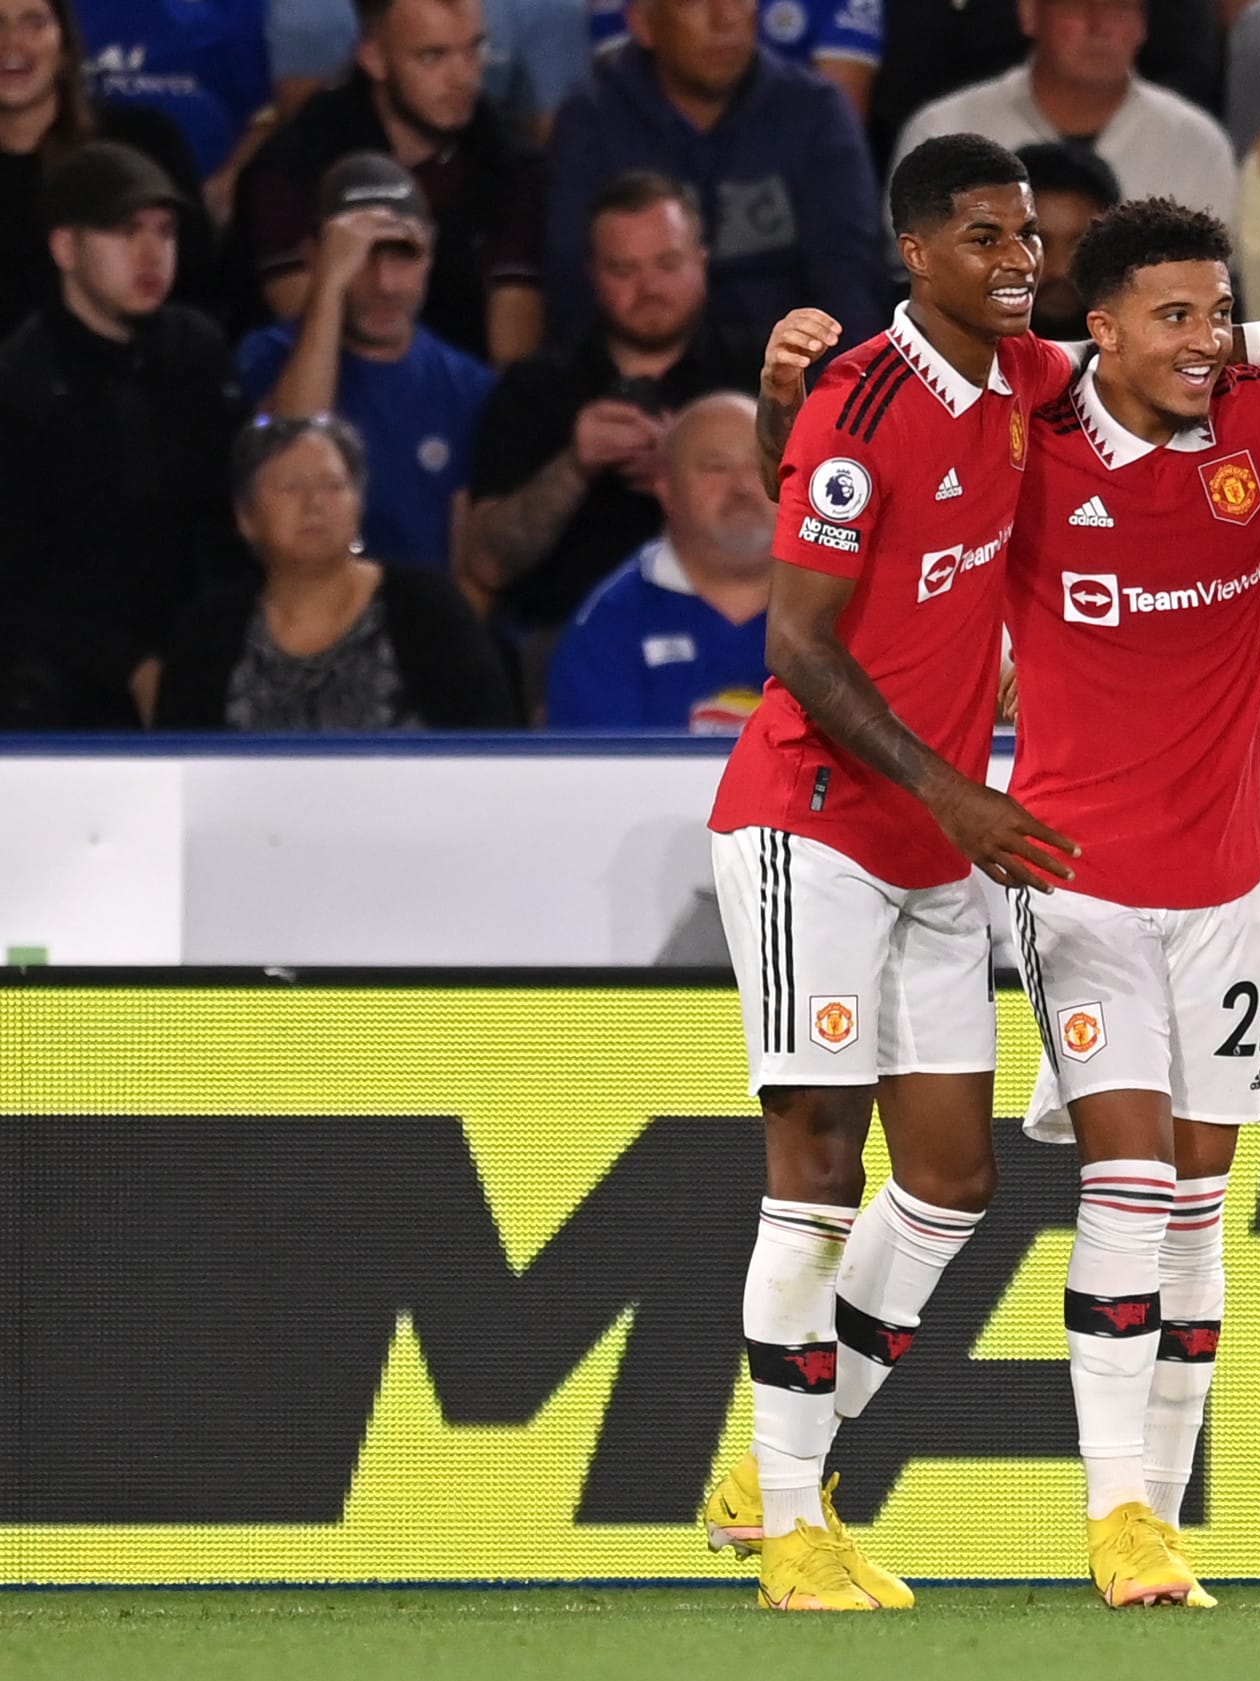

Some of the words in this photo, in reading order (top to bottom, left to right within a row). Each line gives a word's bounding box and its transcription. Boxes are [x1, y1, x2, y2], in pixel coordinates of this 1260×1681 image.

[801, 516, 822, 533] No
[821, 523, 857, 542] room
[1068, 513, 1115, 529] adidas
